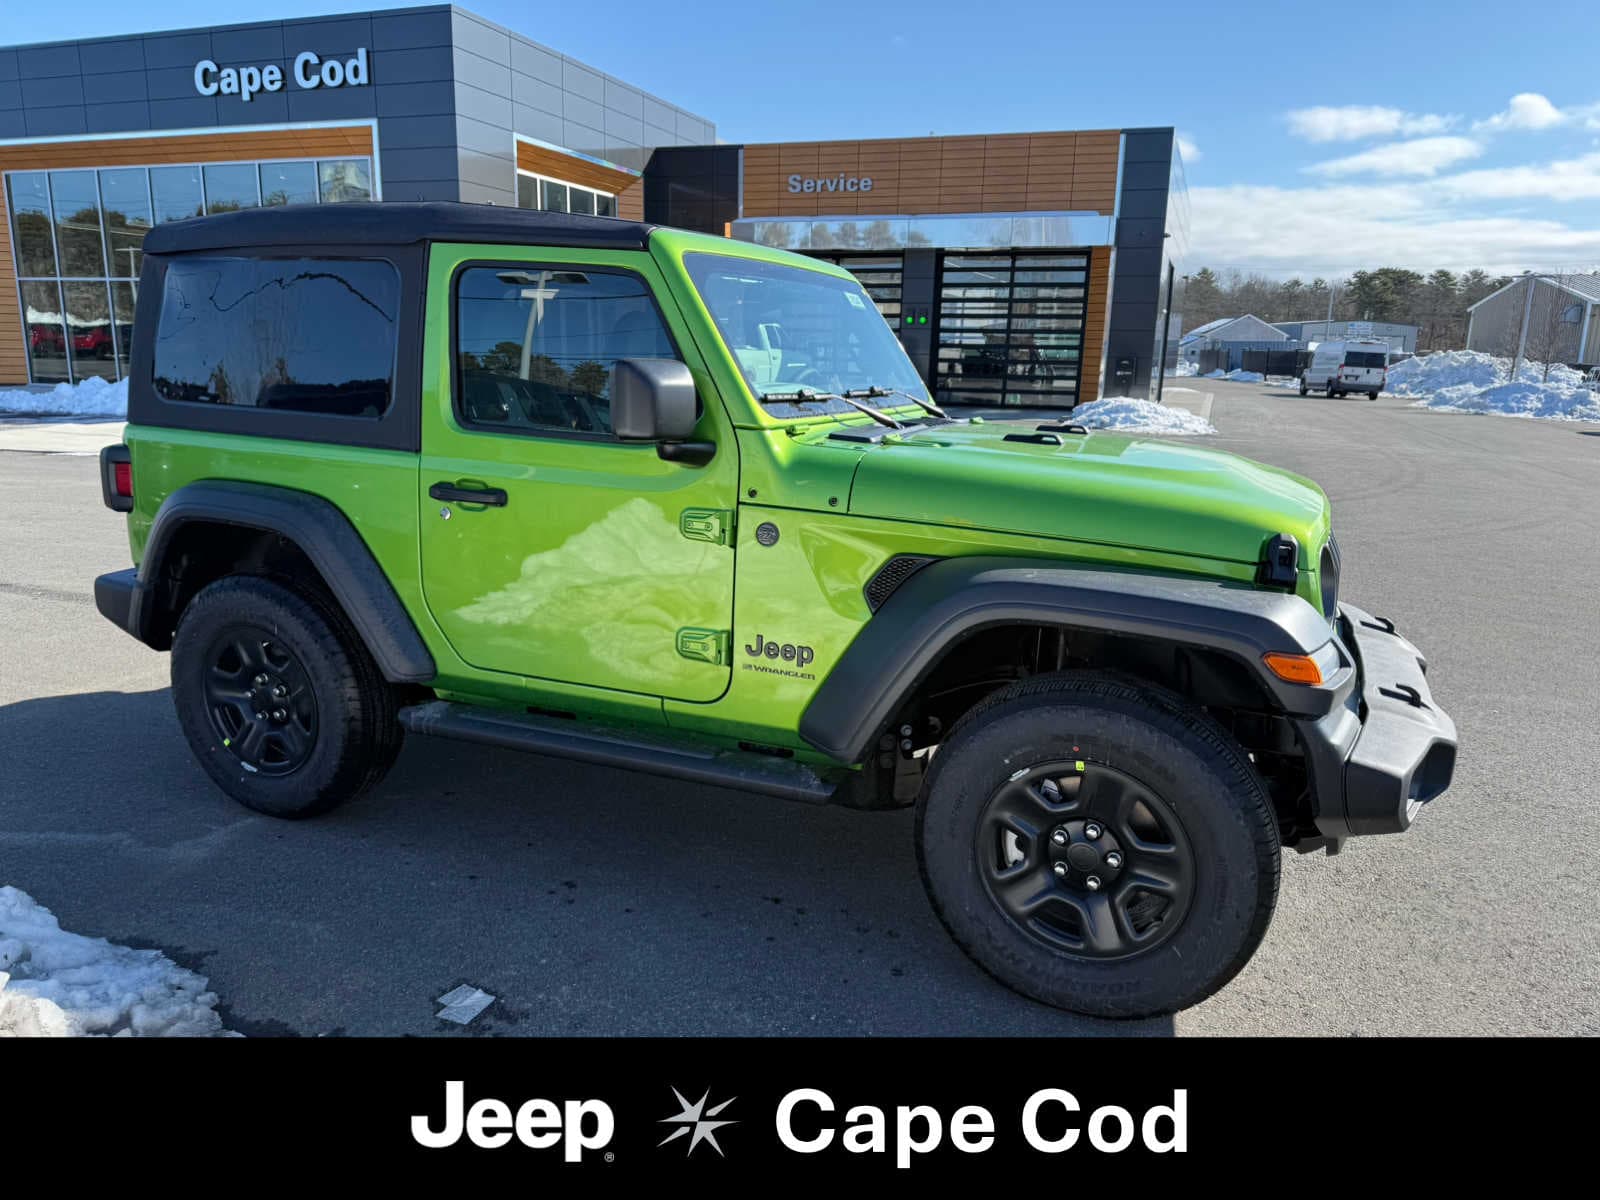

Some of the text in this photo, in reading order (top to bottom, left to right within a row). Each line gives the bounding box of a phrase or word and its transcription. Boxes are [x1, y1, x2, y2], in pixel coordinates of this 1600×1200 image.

[194, 47, 369, 101] Cape Cod
[788, 173, 873, 193] Service
[745, 634, 814, 668] Jeep
[753, 664, 816, 680] WRANGLER
